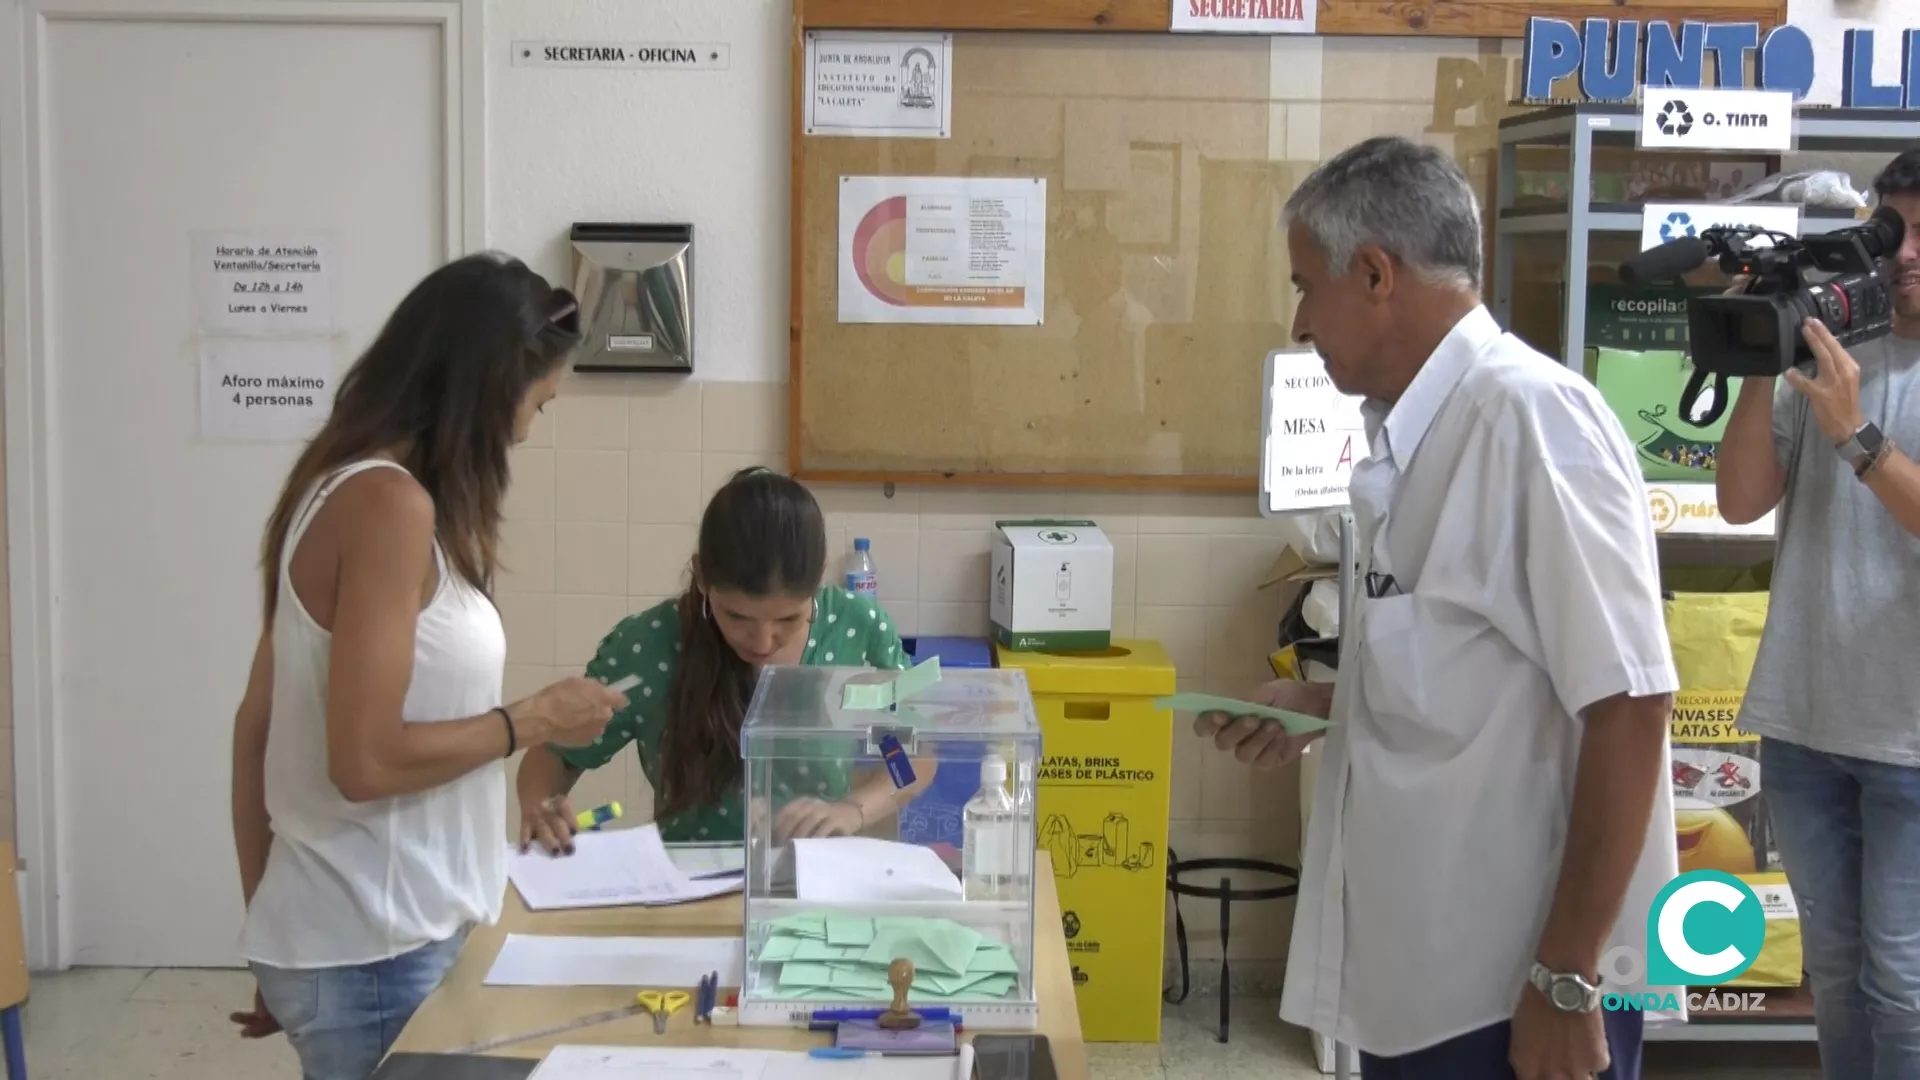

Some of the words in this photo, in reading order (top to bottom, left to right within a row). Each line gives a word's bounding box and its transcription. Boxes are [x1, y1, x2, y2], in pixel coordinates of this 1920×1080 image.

[544, 46, 625, 62] SECRETARIA
[638, 47, 697, 63] OFICINA
[1525, 16, 1815, 103] PUNTO
[1725, 112, 1768, 127] TINTA
[216, 245, 254, 257] Horario
[258, 245, 271, 257] de
[274, 245, 318, 257] Atención
[233, 281, 248, 293] De
[228, 303, 256, 313] Lunes
[270, 303, 308, 313] Viernes
[221, 373, 263, 388] Aforo
[266, 375, 325, 389] máximo
[232, 392, 241, 405] 4
[245, 395, 314, 408] personas
[1283, 418, 1326, 436] MESA
[1282, 465, 1293, 477] De
[1295, 464, 1303, 476] la
[1304, 463, 1324, 475] letra
[1672, 708, 1734, 722] NVASES
[1084, 757, 1120, 768] BRIKS
[1037, 769, 1072, 779] VASES
[1075, 769, 1092, 779] DE
[1095, 768, 1154, 781] PLÁSTICO
